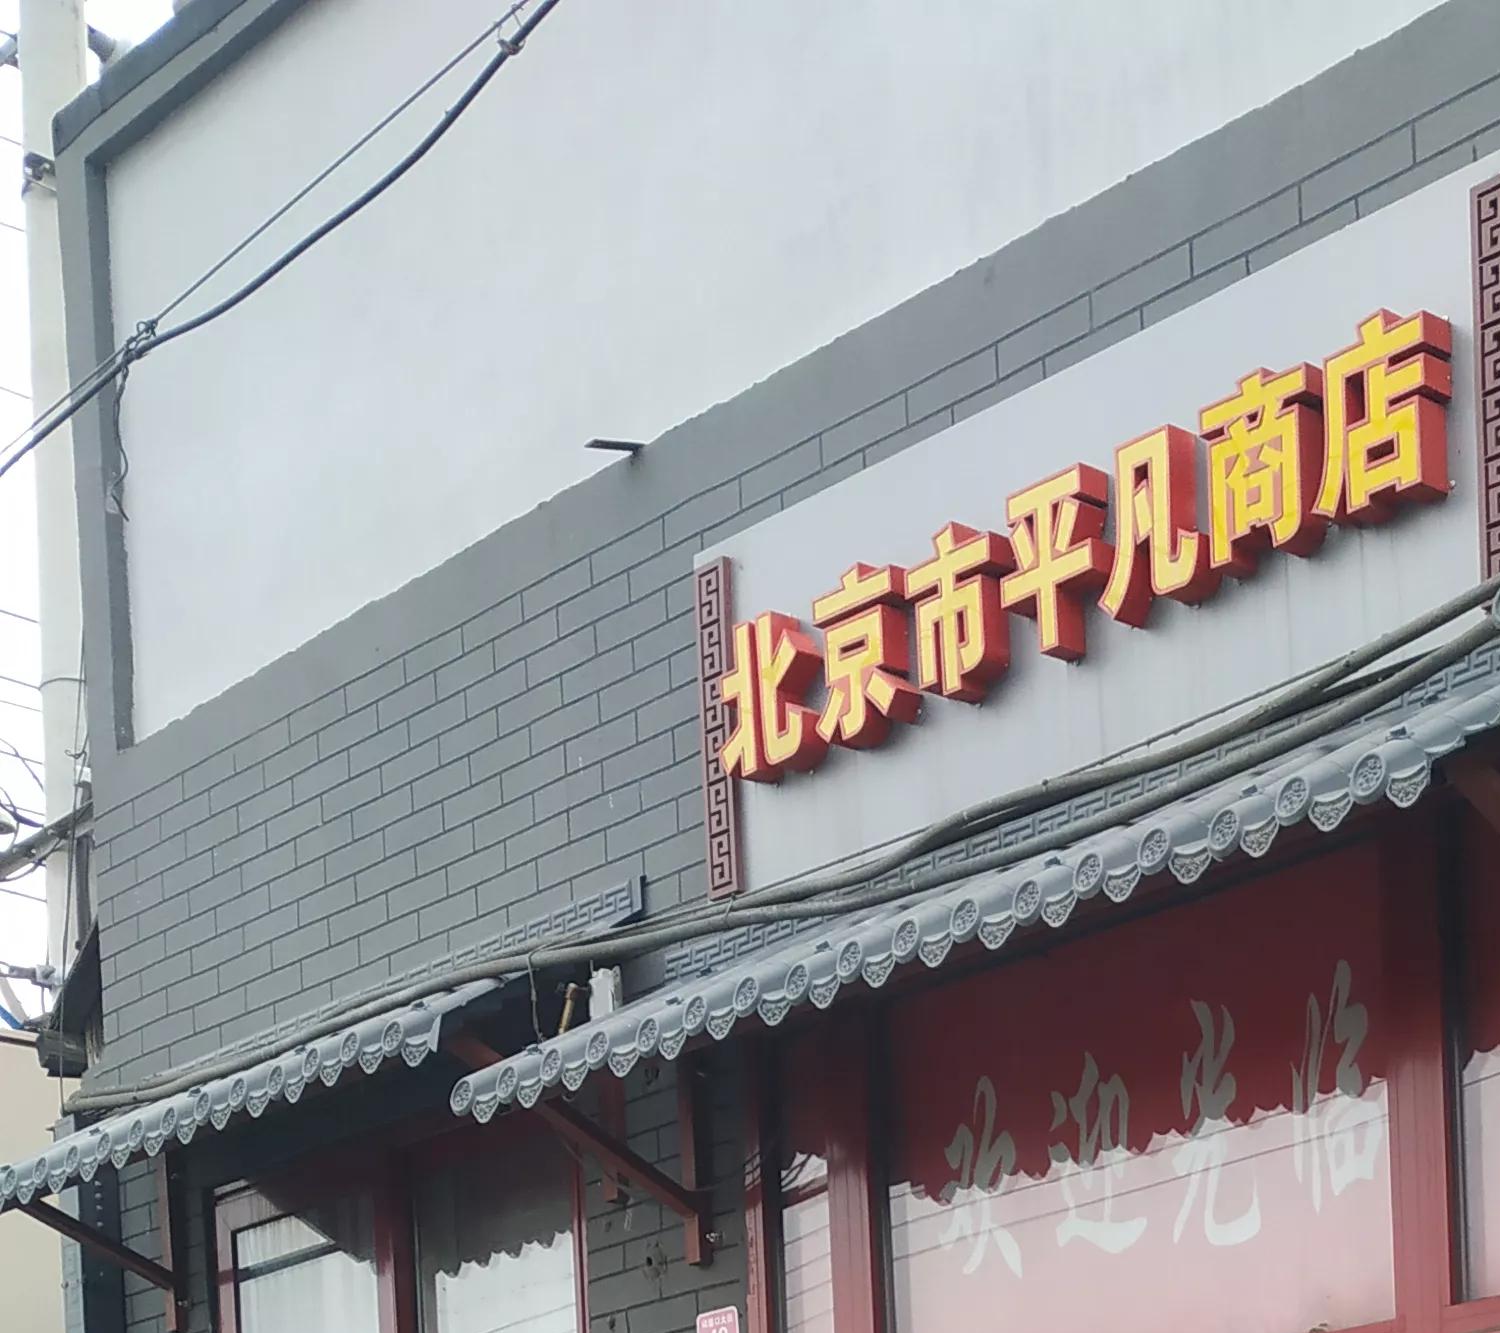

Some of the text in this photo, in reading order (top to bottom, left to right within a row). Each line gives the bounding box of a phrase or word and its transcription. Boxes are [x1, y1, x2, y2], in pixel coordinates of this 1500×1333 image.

[720, 308, 1453, 784] 北京市平凡商店
[938, 959, 1388, 1279] 欢迎光临
